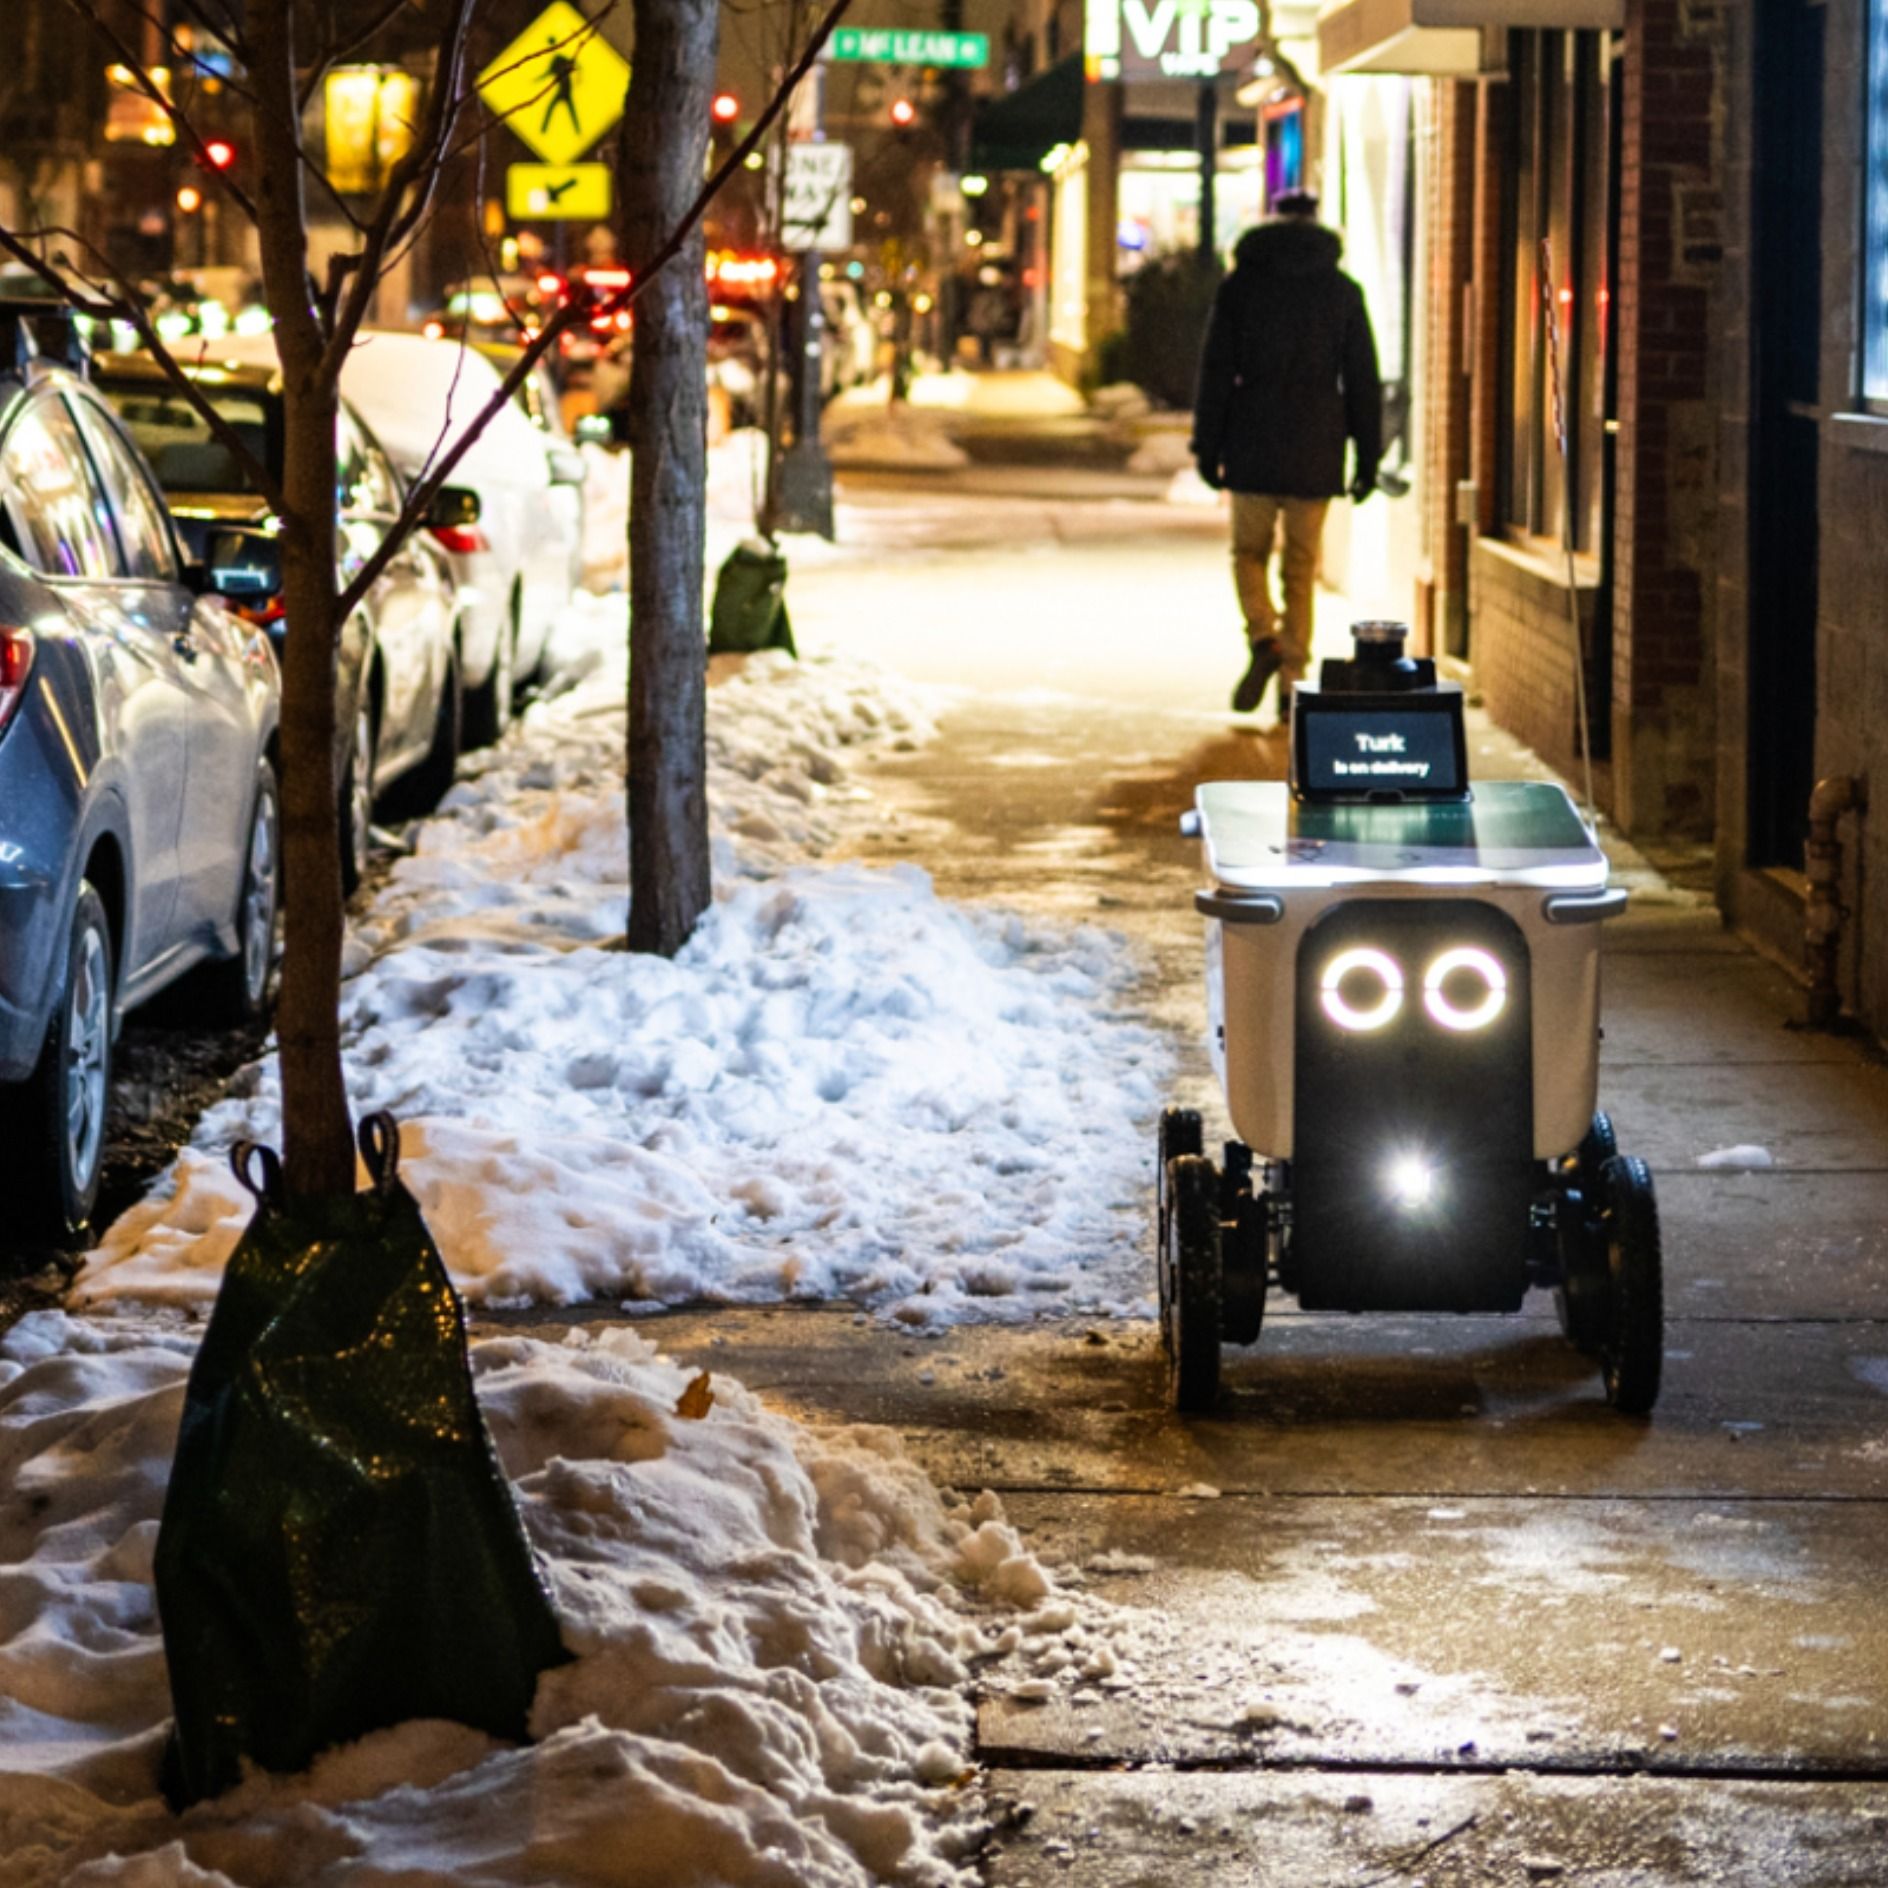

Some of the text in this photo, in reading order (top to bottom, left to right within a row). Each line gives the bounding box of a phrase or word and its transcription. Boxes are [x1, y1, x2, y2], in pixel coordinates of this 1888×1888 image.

[1123, 0, 1259, 57] VIP
[1355, 733, 1406, 752] Turk
[1349, 761, 1369, 774] on
[1370, 760, 1430, 778] delivery
